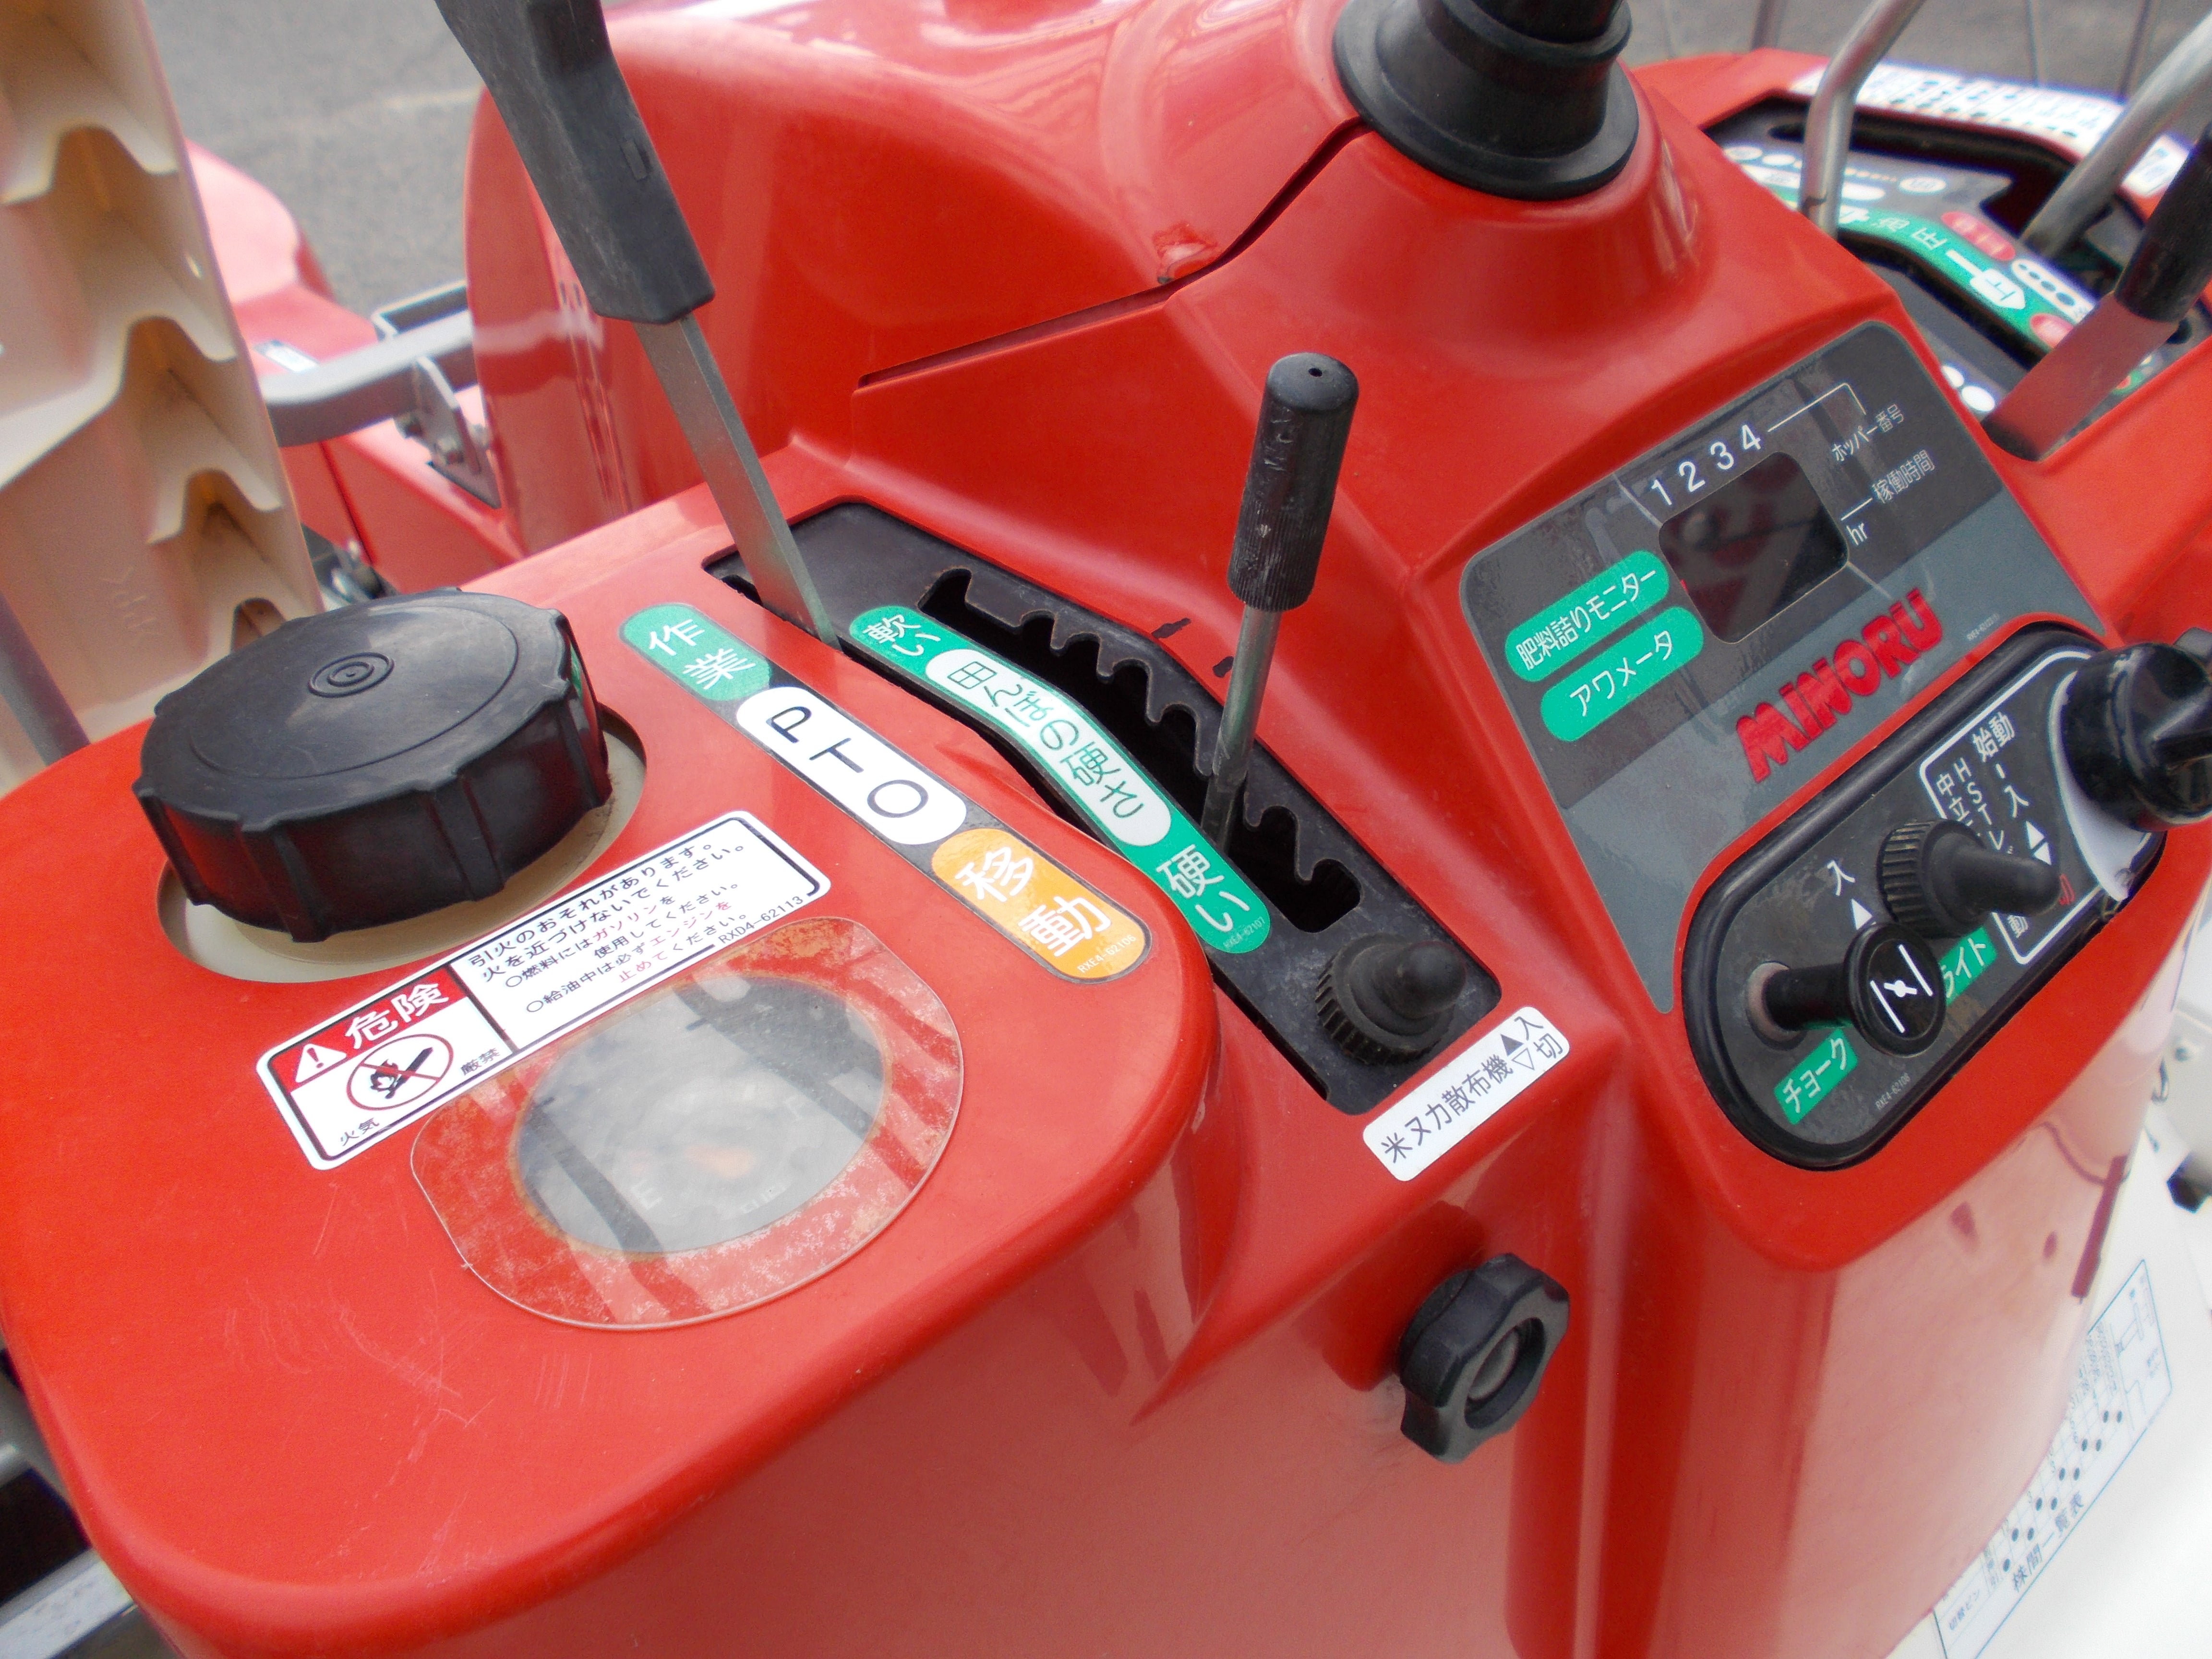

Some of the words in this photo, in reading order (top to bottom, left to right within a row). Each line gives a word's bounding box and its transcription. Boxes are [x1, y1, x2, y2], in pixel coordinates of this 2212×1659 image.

[1651, 479, 1672, 505] 1
[1679, 461, 1706, 493] 2
[1710, 442, 1734, 470] 3
[1742, 424, 1761, 450] 4
[1832, 404, 1904, 462] ホッパー番号
[1872, 449, 1936, 504] 稼働時間
[1846, 522, 1868, 546] hr
[648, 617, 757, 690] 作業
[863, 613, 941, 658] 軟い
[1515, 570, 1657, 671] 肥料詰りモニター
[1569, 630, 1673, 717] アワメータ
[765, 705, 929, 818] PTO
[947, 661, 1143, 819] 田んぼの硬さ
[1972, 711, 2016, 763] 始動
[468, 843, 712, 967] 引火のおそれがあります。
[954, 845, 1113, 958] 移動
[1156, 843, 1250, 932] 硬い
[1827, 860, 1856, 897] 入
[482, 845, 744, 983] 火を近づけないでください。
[593, 883, 738, 959] 使用してください。
[618, 914, 747, 984] 止めてください。
[718, 895, 804, 945] RXD4-62113
[1076, 934, 1137, 974] RXE4-62106
[344, 982, 449, 1050] 危険
[1513, 1016, 1544, 1041] 入
[1536, 1033, 1563, 1059] 切
[460, 1047, 501, 1077] 厳禁
[1782, 1037, 1847, 1114] チョーク
[340, 1117, 380, 1147] 火気
[1380, 1053, 1514, 1164] 米ヌカ散布機
